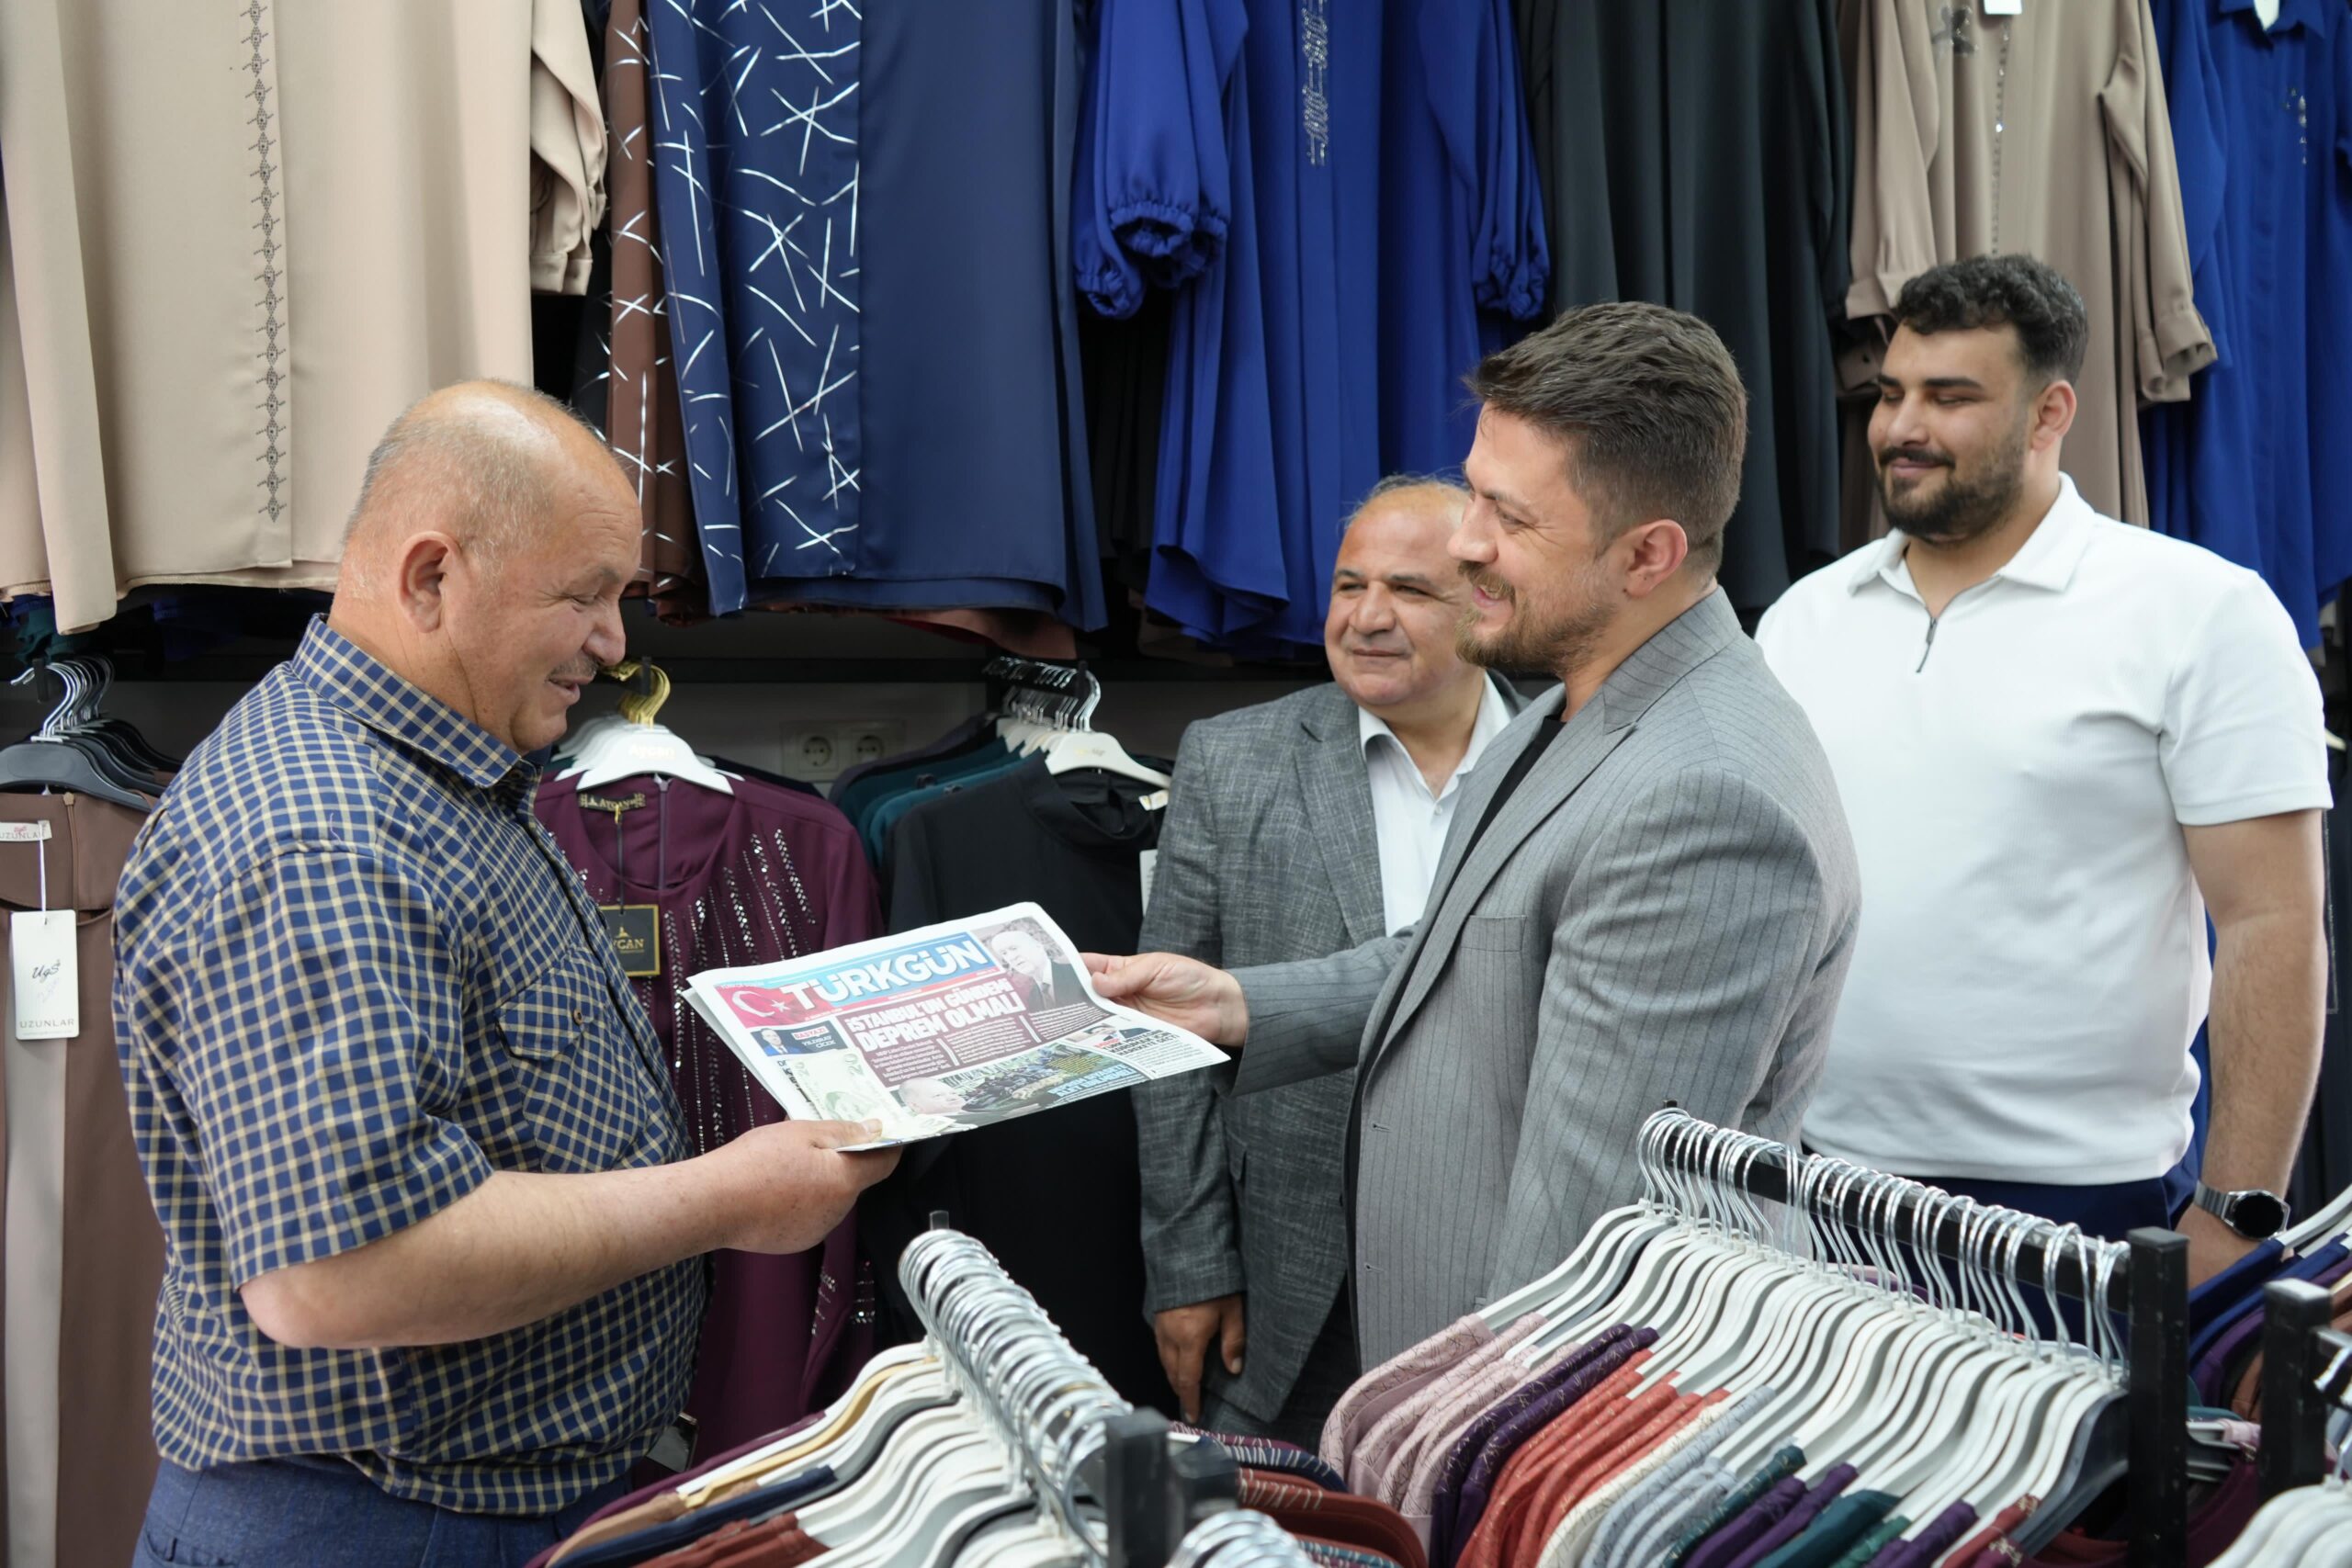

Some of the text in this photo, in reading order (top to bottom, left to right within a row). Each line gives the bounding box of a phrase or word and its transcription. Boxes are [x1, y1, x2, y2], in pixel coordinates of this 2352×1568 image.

[613, 938, 645, 950] CAN
[779, 939, 989, 1010] TÜRKGÜN
[19, 1019, 74, 1029] UZUNLAR
[854, 1015, 949, 1052] DEPREM
[944, 991, 1026, 1028] OLMALI
